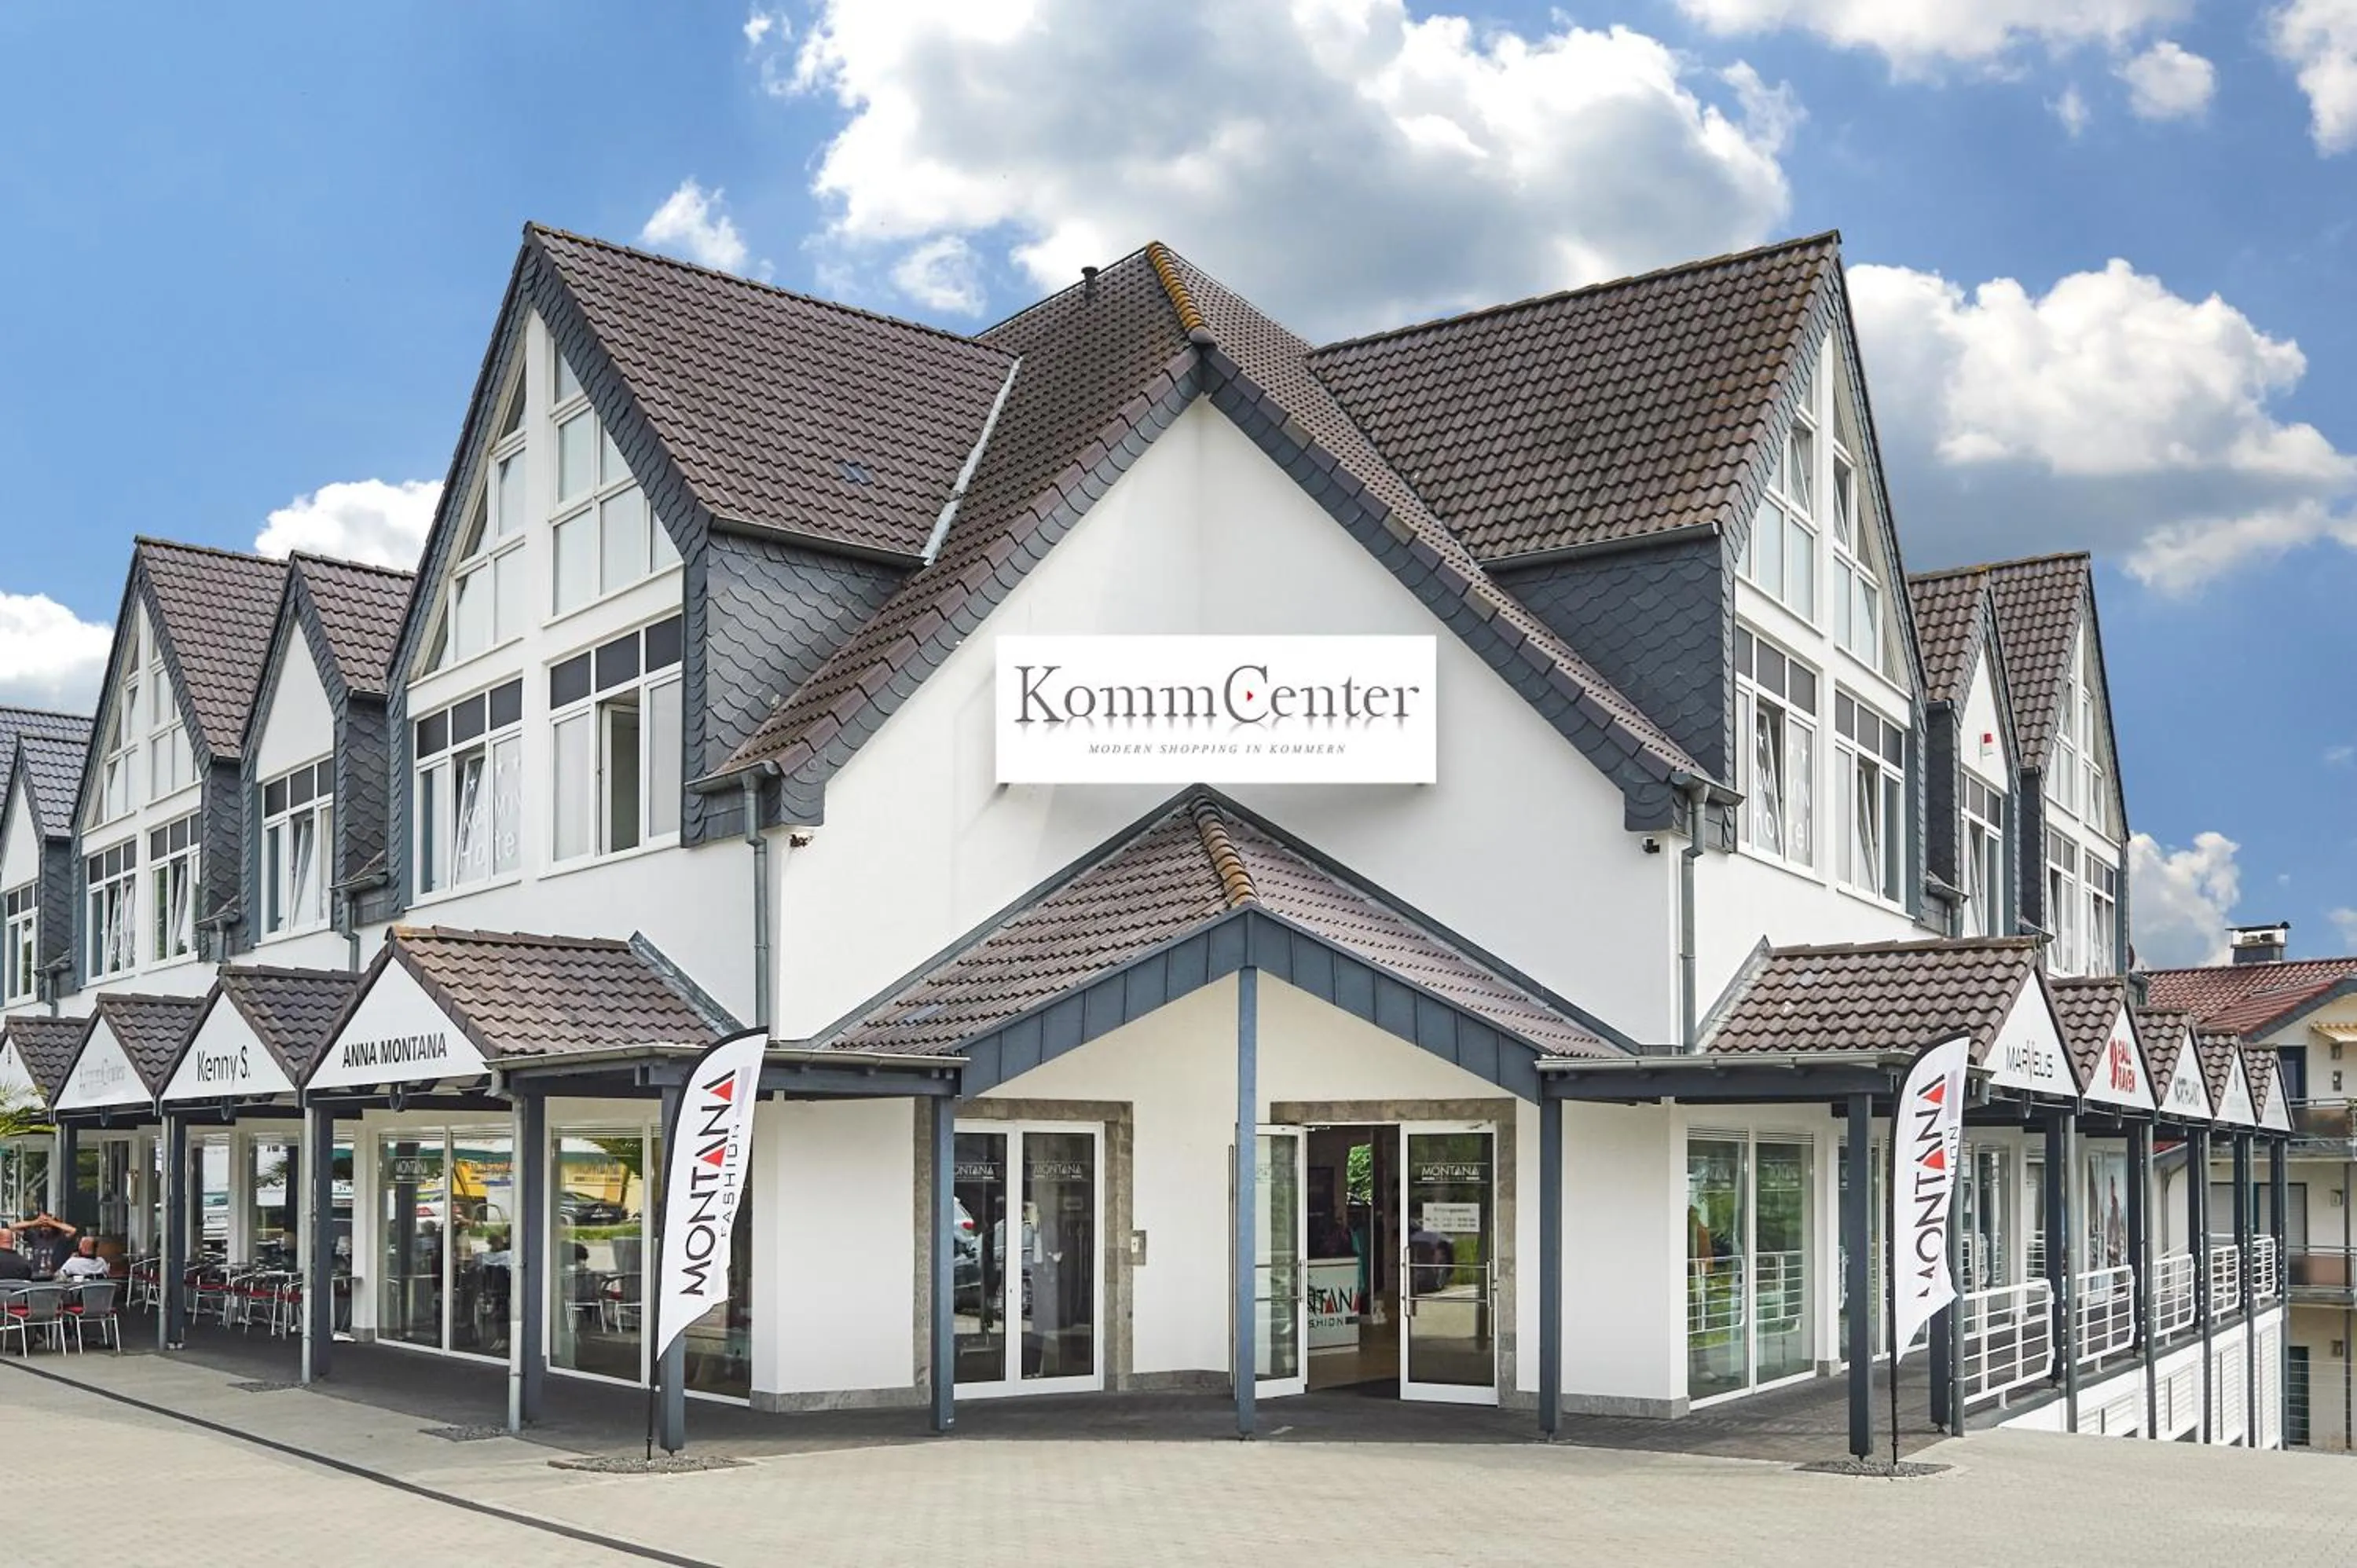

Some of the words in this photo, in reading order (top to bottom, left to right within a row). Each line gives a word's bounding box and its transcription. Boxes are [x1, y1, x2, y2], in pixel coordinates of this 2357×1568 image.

[1014, 665, 1420, 724] KommCenter
[1088, 743, 1153, 754] MODERN
[1160, 743, 1238, 754] SHOPPING
[1246, 743, 1262, 754] IN
[1269, 743, 1347, 754] KOMMERN
[343, 1041, 378, 1068] ANNA
[379, 1032, 447, 1064] MONTANA
[197, 1050, 238, 1083] Kenny
[240, 1044, 251, 1079] S.
[954, 1165, 994, 1175] ONTANA
[1033, 1163, 1082, 1174] MONTANA
[1421, 1165, 1479, 1176] MONTANA
[679, 1068, 736, 1296] MONTANA
[1307, 1284, 1358, 1315] NTAN
[1307, 1317, 1343, 1328] SHION
